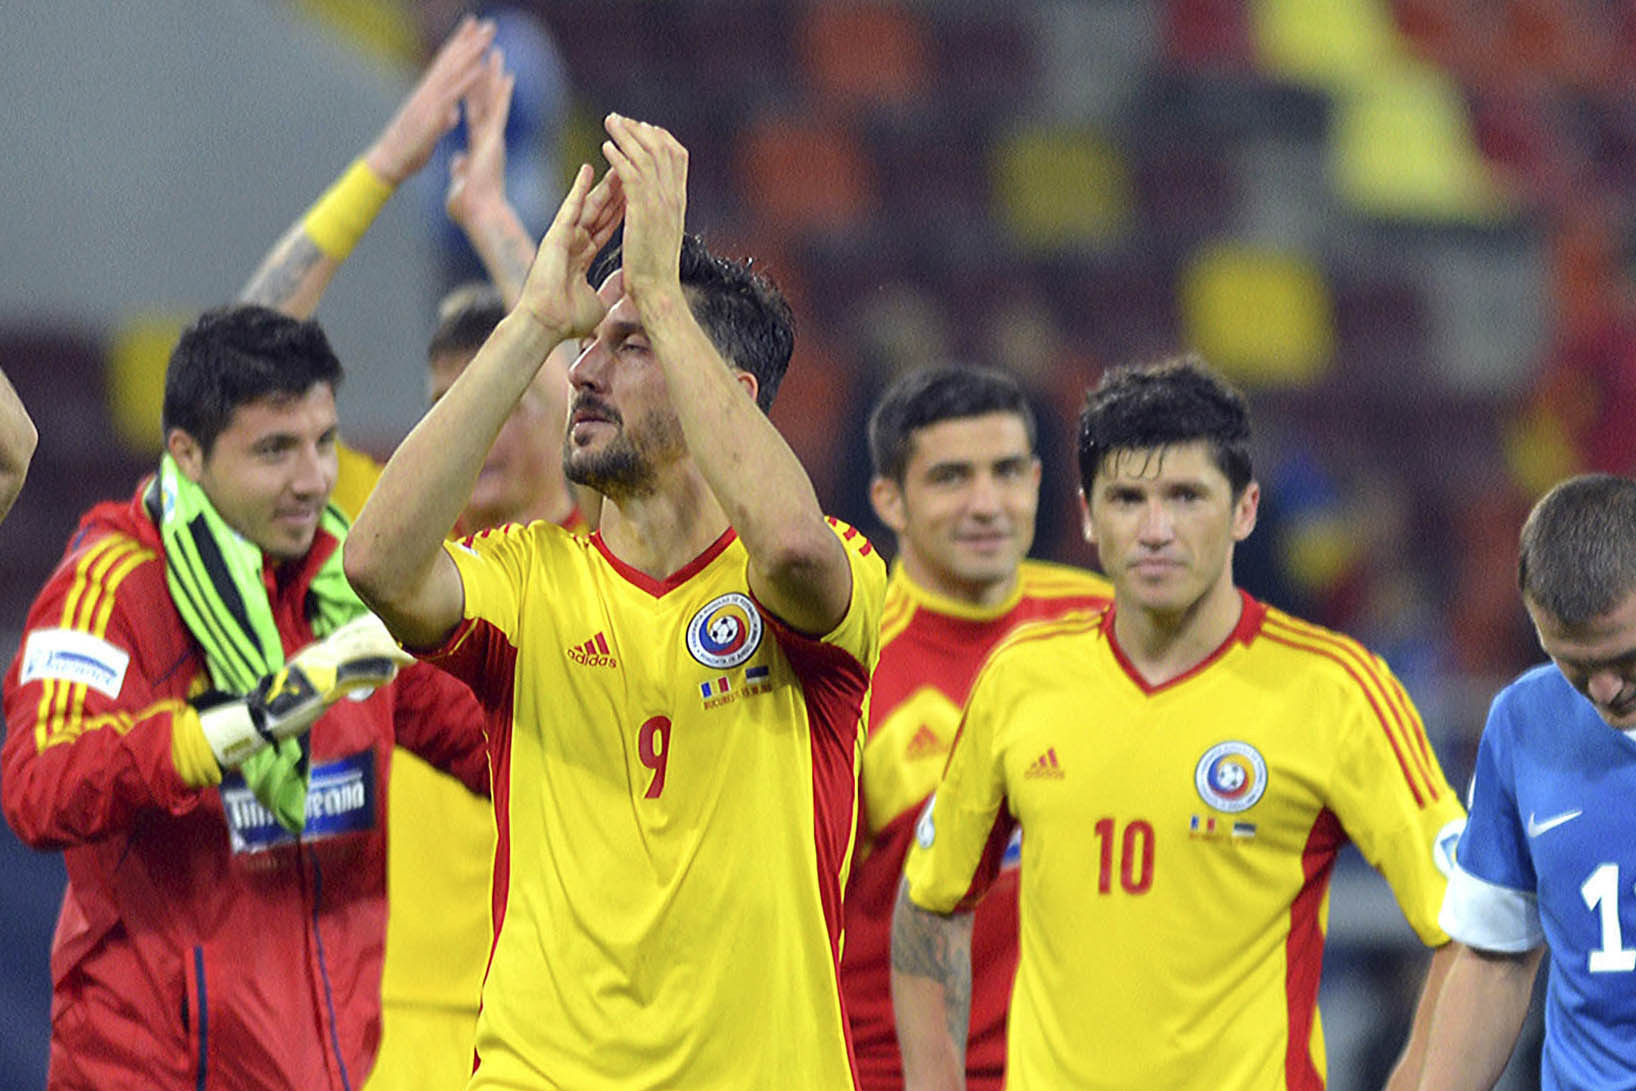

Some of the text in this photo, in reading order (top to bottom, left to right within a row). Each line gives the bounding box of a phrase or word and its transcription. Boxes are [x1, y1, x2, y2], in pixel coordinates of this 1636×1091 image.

[568, 648, 617, 669] adidas
[638, 715, 672, 799] 9
[1095, 817, 1155, 895] 10
